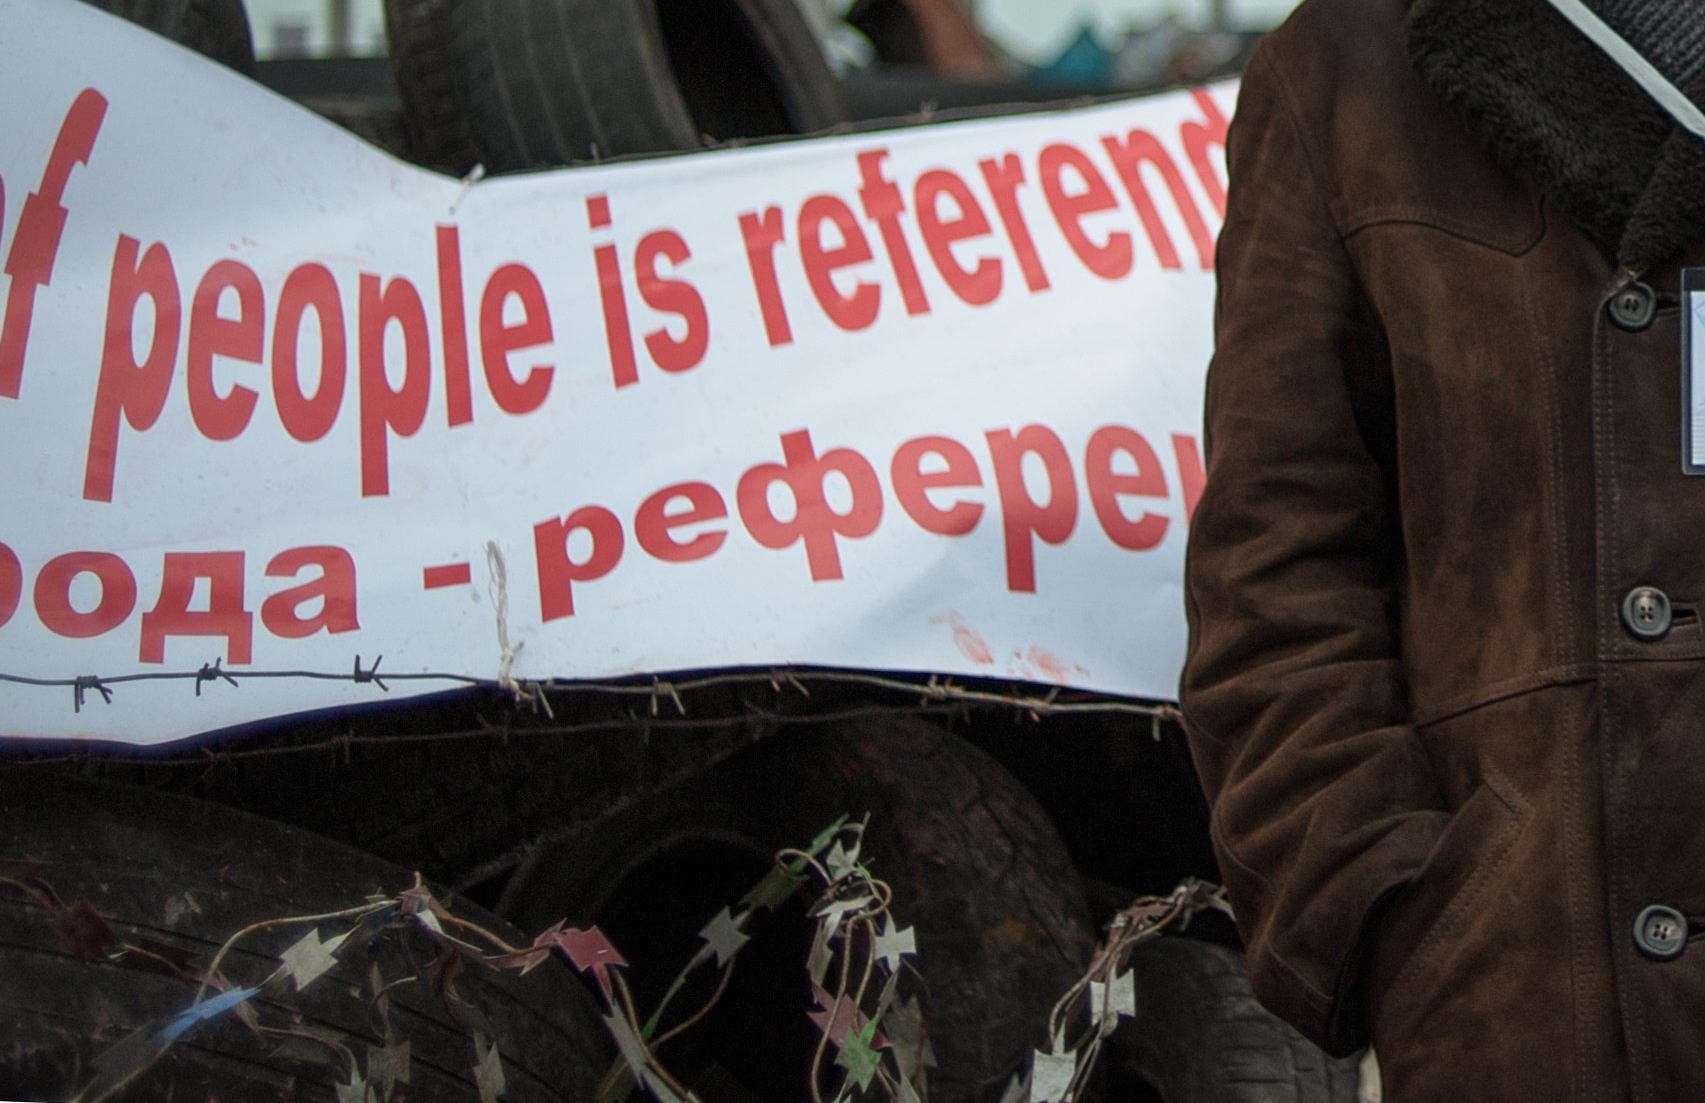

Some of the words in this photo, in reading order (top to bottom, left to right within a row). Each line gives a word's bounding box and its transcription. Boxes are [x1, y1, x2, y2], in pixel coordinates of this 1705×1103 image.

[0, 86, 109, 400] f
[83, 224, 556, 504] people
[587, 195, 709, 389] is
